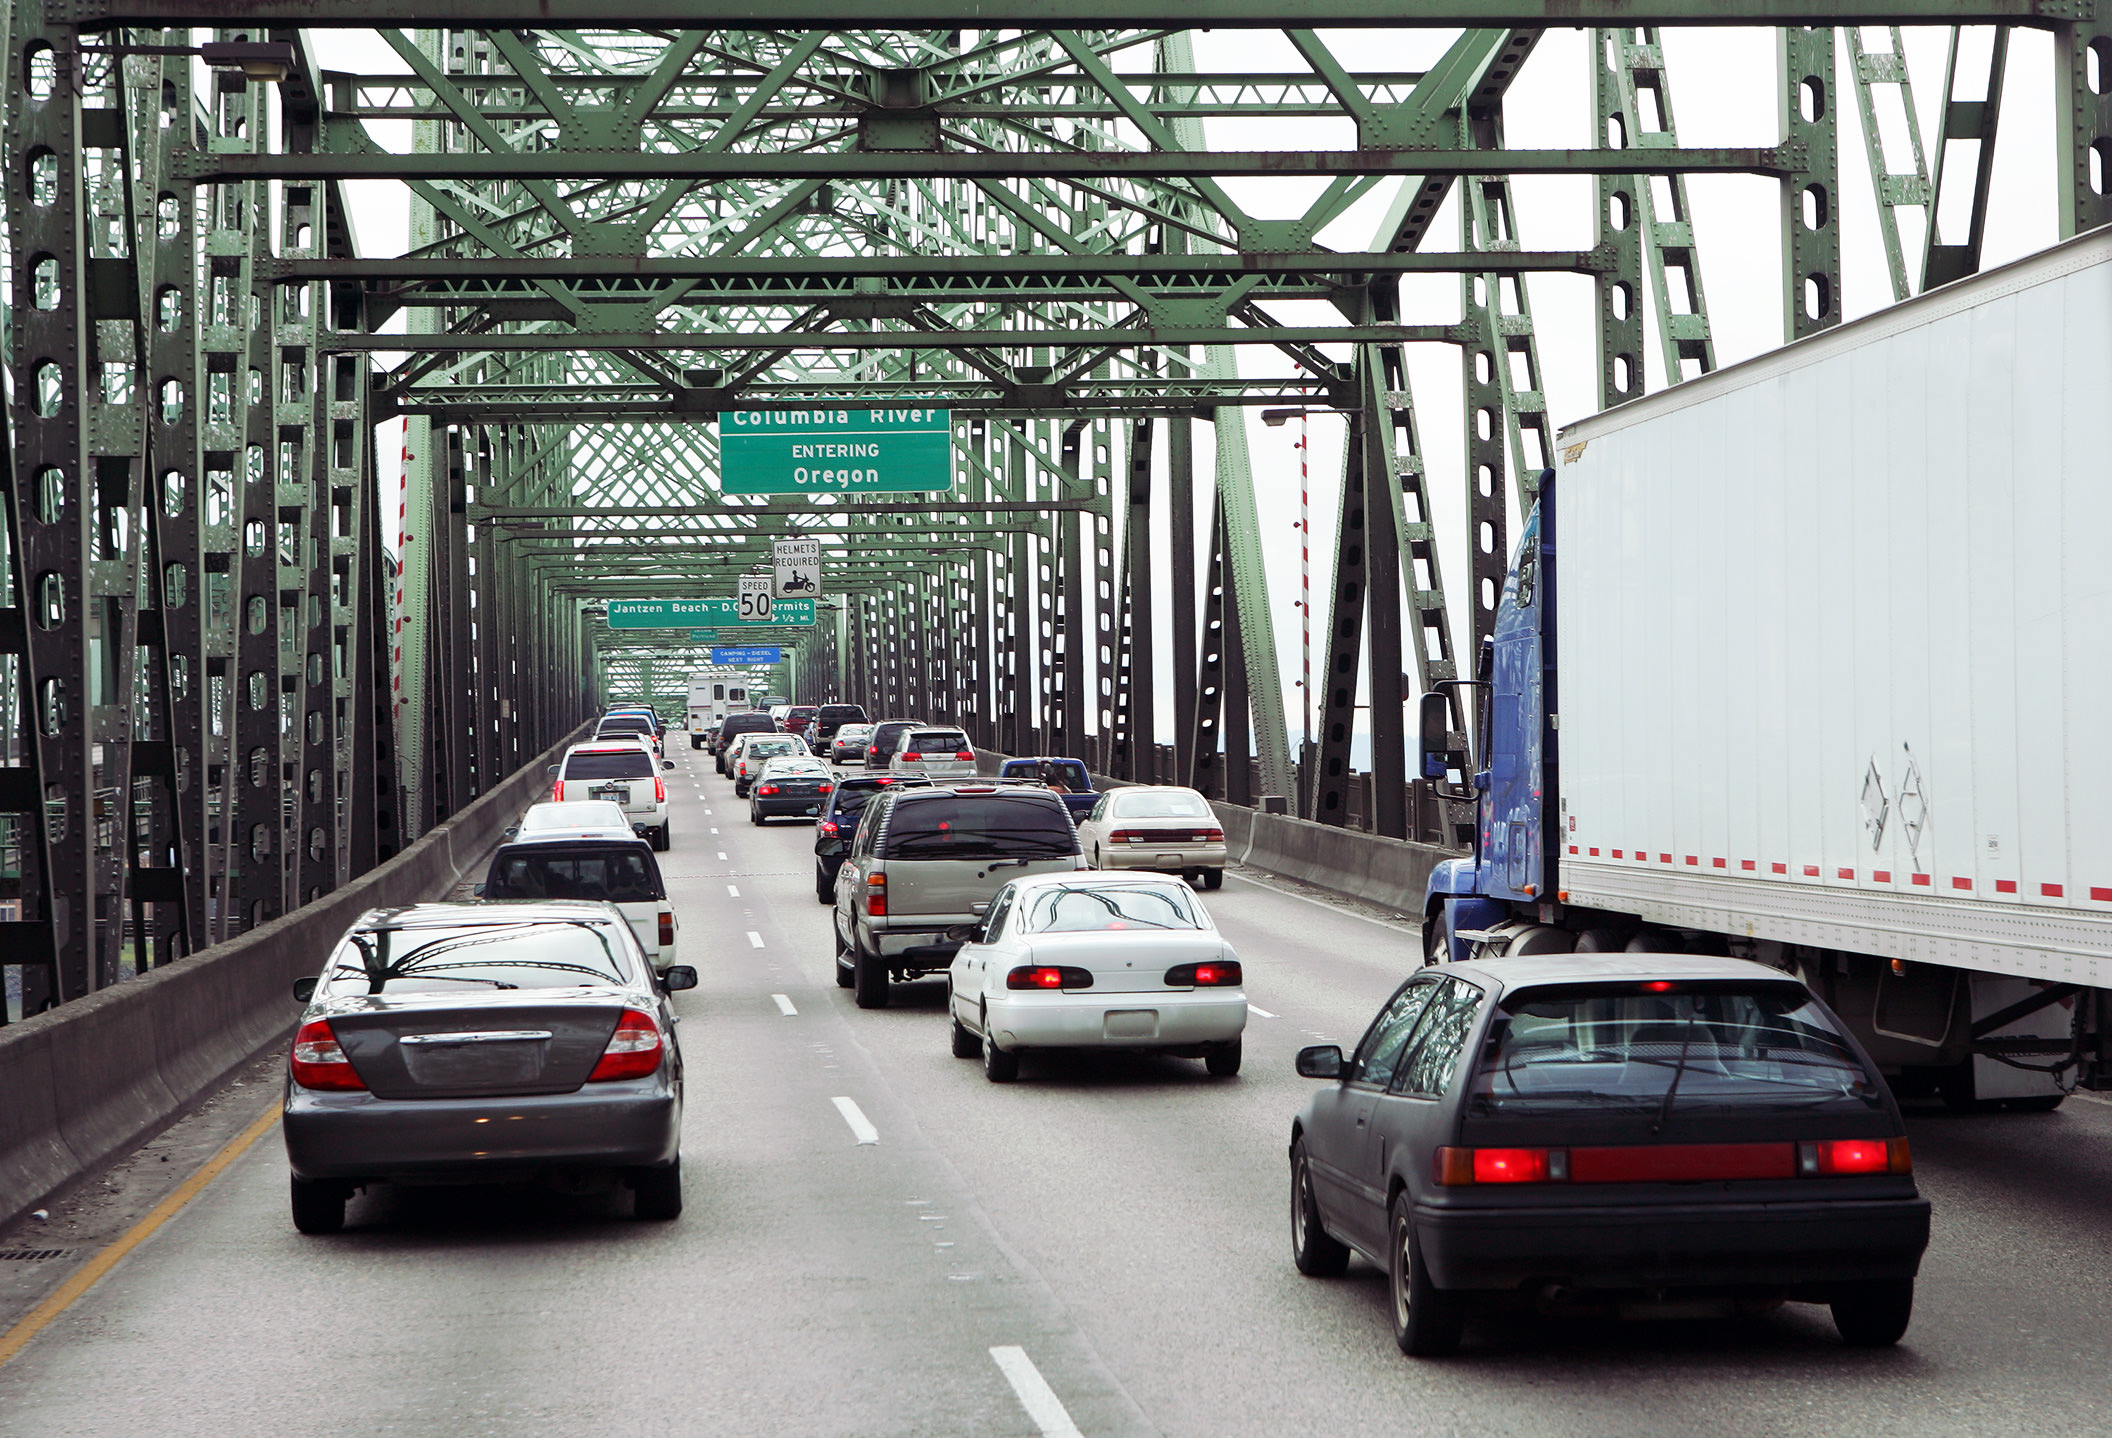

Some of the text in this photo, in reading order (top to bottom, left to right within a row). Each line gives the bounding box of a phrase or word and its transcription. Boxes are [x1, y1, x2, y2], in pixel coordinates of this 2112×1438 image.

[733, 409, 936, 425] Columbia River
[792, 443, 880, 458] ENTERING
[793, 467, 879, 488] Oregon
[776, 543, 817, 554] HELMETS
[775, 557, 819, 567] REQUIRED
[742, 582, 768, 590] SPEED
[613, 604, 663, 613] Jantzen
[672, 603, 709, 612] Beach
[772, 601, 810, 611] ermits
[741, 593, 770, 616] 50
